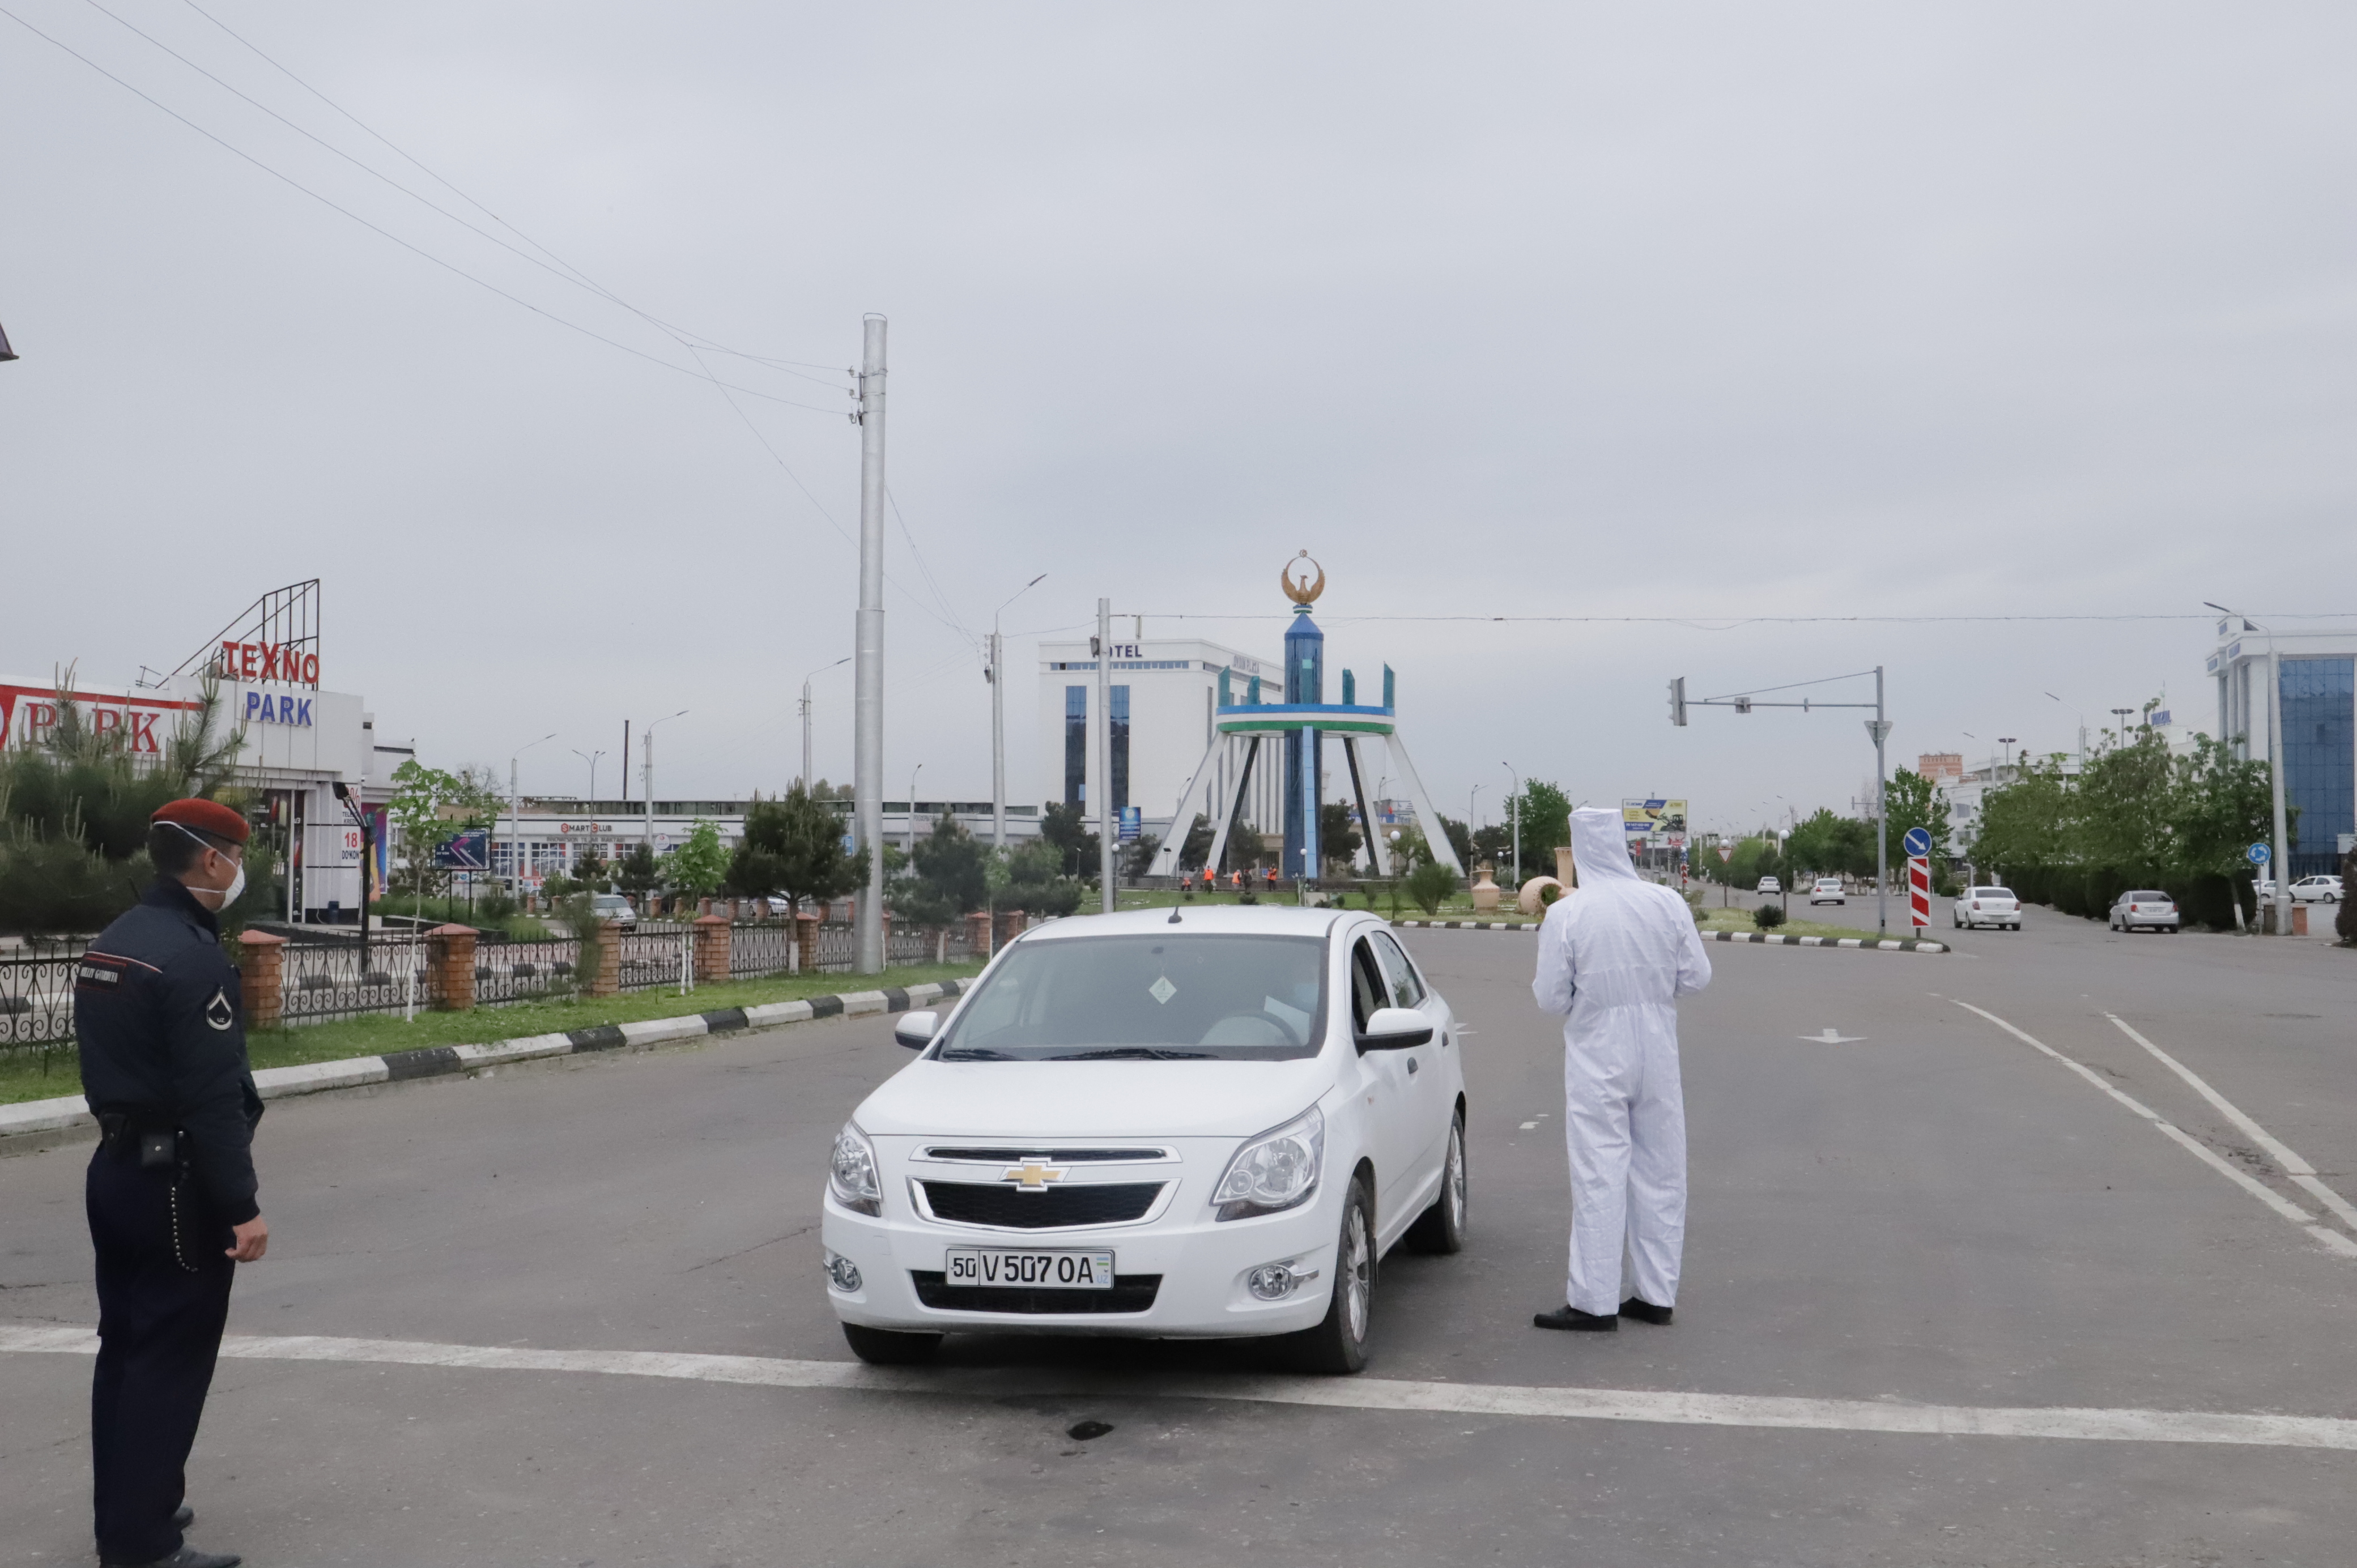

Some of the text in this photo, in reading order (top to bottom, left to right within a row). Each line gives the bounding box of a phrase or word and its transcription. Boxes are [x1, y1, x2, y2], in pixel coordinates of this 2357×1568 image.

[223, 641, 320, 684] TEXNO
[246, 692, 312, 726] PARK
[25, 702, 160, 752] PRK
[561, 823, 612, 833] SMART CLUB
[344, 832, 358, 847] 18
[953, 1258, 976, 1277] 50
[1096, 1274, 1109, 1284] UZ
